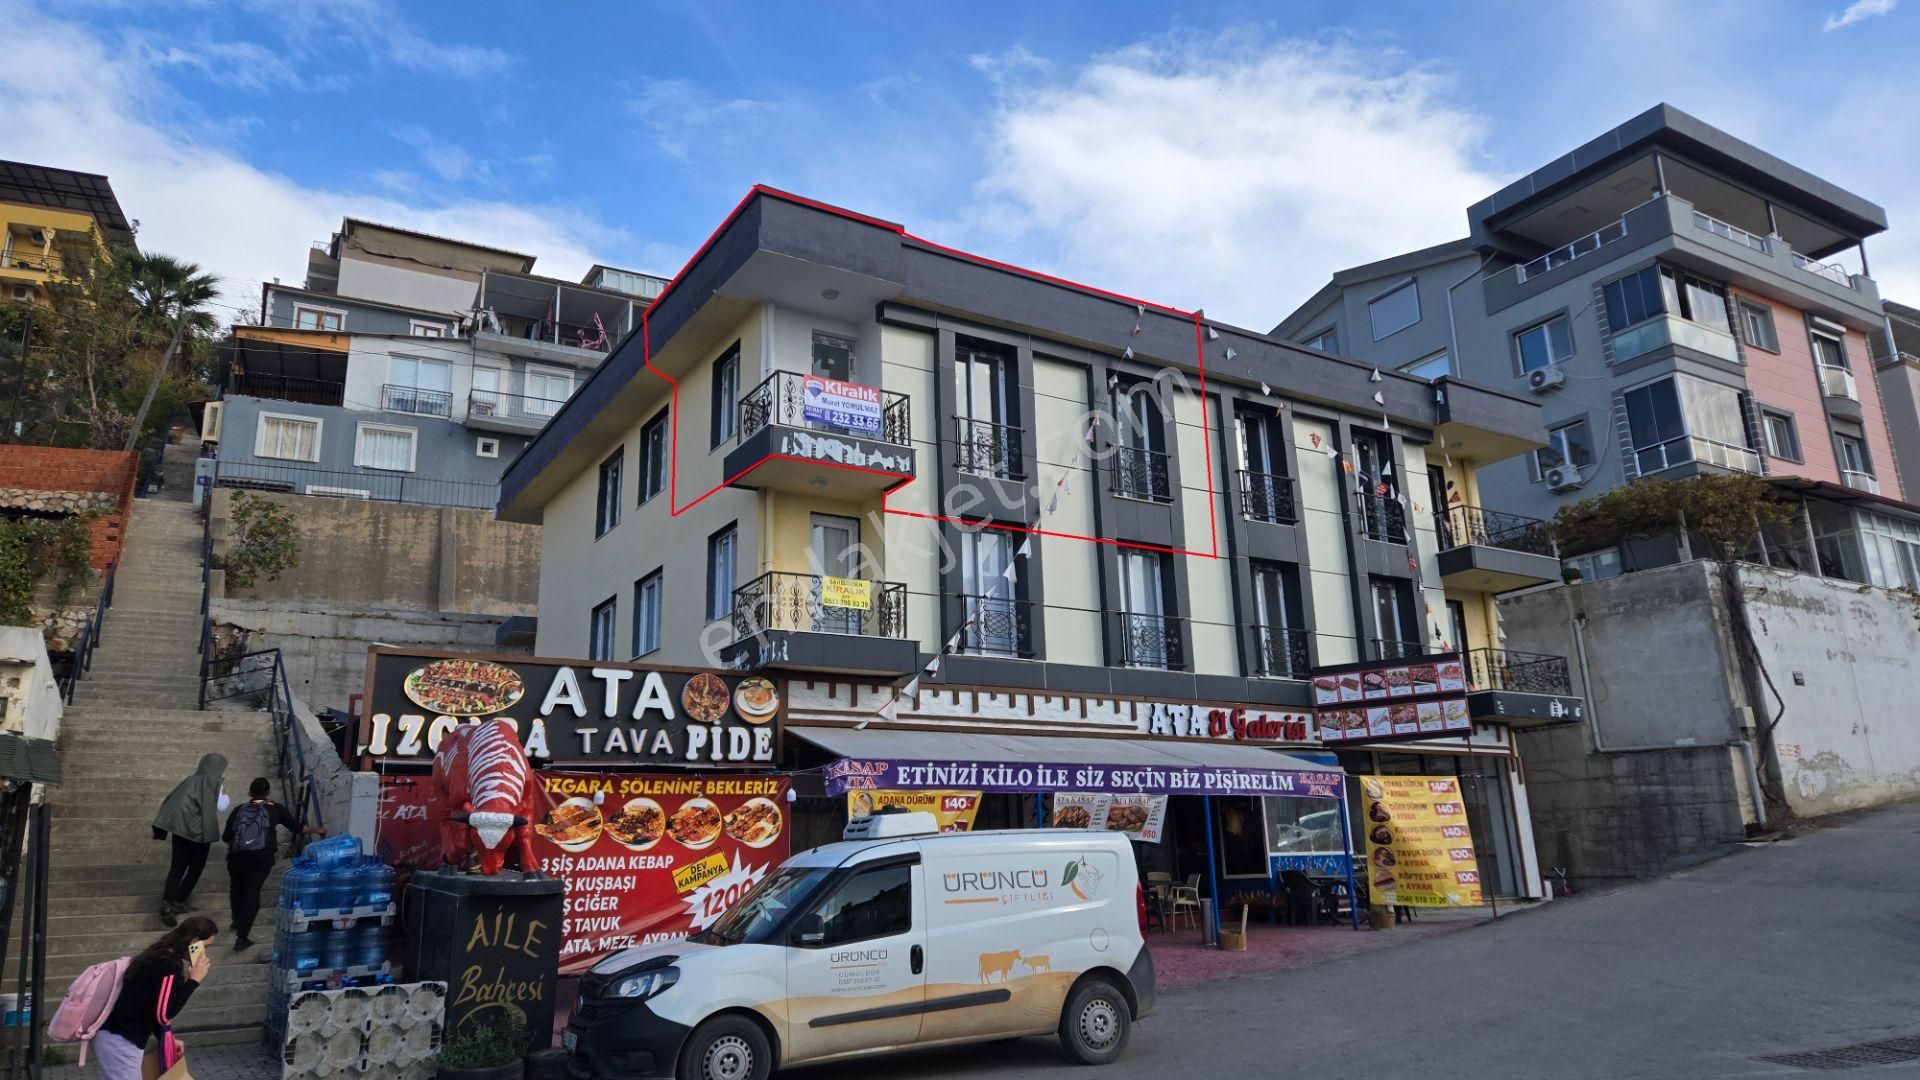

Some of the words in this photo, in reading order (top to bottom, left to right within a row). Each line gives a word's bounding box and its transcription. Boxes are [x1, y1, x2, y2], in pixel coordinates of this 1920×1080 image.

[824, 381, 880, 402] Kiralık
[831, 412, 851, 424] 232
[852, 415, 864, 426] 33
[866, 418, 879, 429] 66
[540, 666, 676, 721] ATA
[1150, 702, 1205, 737] ATA
[1230, 706, 1308, 741] Galerisi
[368, 713, 551, 758] IZGA
[575, 727, 674, 755] TAVA
[685, 719, 774, 762] PİDE
[897, 762, 977, 786] ETİNİZİ
[981, 764, 1033, 786] KİLO
[1037, 764, 1069, 787] İLE
[1075, 766, 1105, 788] SİZ
[1111, 767, 1167, 792] SEÇİN
[1169, 768, 1200, 789] BİZ
[1203, 769, 1295, 794] PİŞİRELİM
[1299, 772, 1341, 786] KASAP
[544, 778, 614, 794] IZGARA
[619, 777, 703, 799] ŞÖLENİNE
[705, 777, 778, 795] BEKLERİZ
[878, 796, 905, 806] ADANA
[907, 795, 936, 805] DÜRÜM
[393, 804, 429, 821] ATA
[541, 858, 549, 872] 3
[551, 854, 574, 874] ŞİŞ
[576, 856, 626, 872] ADANA
[628, 855, 674, 870] KEBAP
[690, 861, 707, 875] DEV
[1404, 859, 1431, 867] AYRAN
[575, 875, 637, 894] KUŞBAŞI
[677, 864, 724, 889] KAMPANYA
[943, 869, 1048, 892] ÜRÜNCÜ
[1405, 883, 1434, 891] AYRAN
[574, 894, 619, 912] CİĞER
[465, 904, 548, 959] AİLE
[574, 916, 622, 933] TAVUK
[559, 938, 595, 955] ATA,
